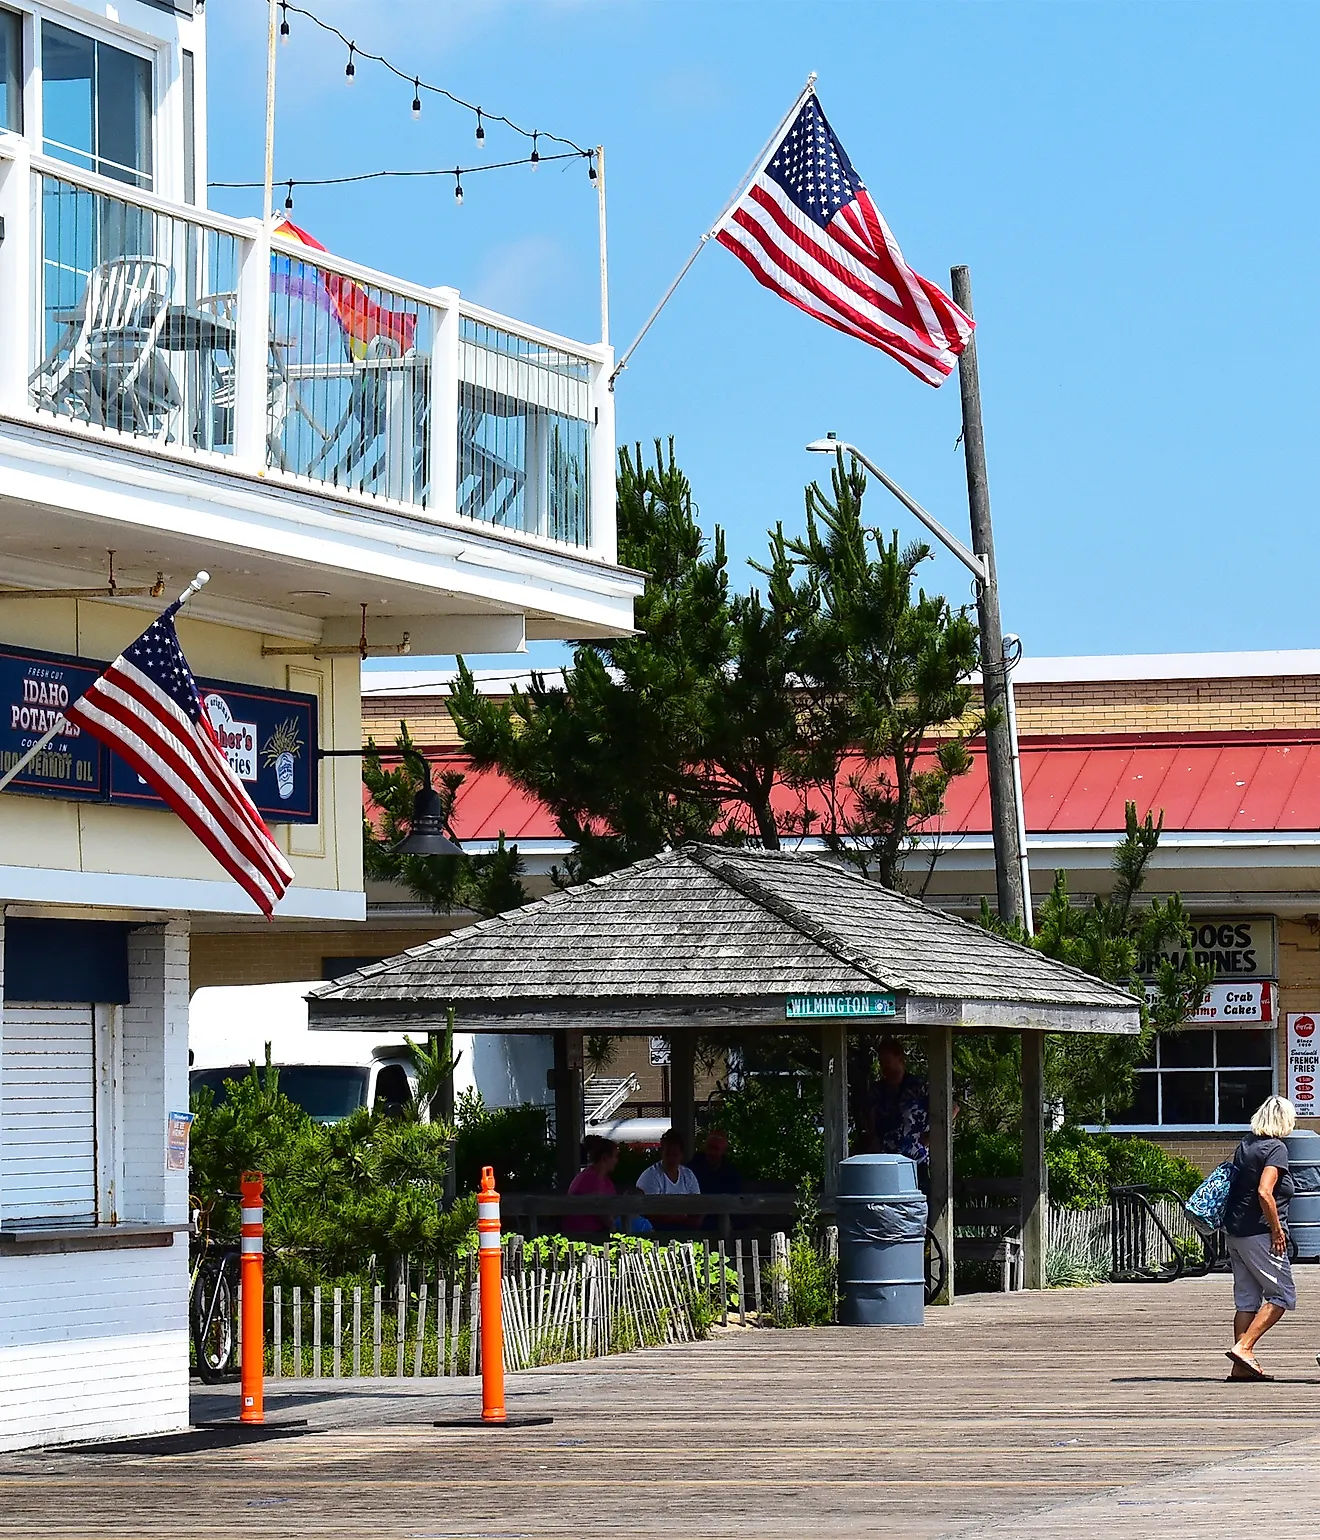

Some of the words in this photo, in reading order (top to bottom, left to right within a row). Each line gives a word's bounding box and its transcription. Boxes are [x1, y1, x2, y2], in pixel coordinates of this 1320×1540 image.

[28, 667, 49, 678] FRESH
[51, 671, 64, 680] CUT
[23, 679, 69, 707] IDAHO
[21, 739, 53, 750] COOED
[59, 743, 67, 752] IN
[75, 760, 93, 782] OIL
[1181, 924, 1252, 949] DOGS
[1226, 992, 1253, 1002] Crab
[790, 997, 869, 1014] WILMINGTON
[1224, 1005, 1257, 1015] Cakes
[1290, 1057, 1319, 1065] FRENCH
[1294, 1065, 1315, 1073] FRIES
